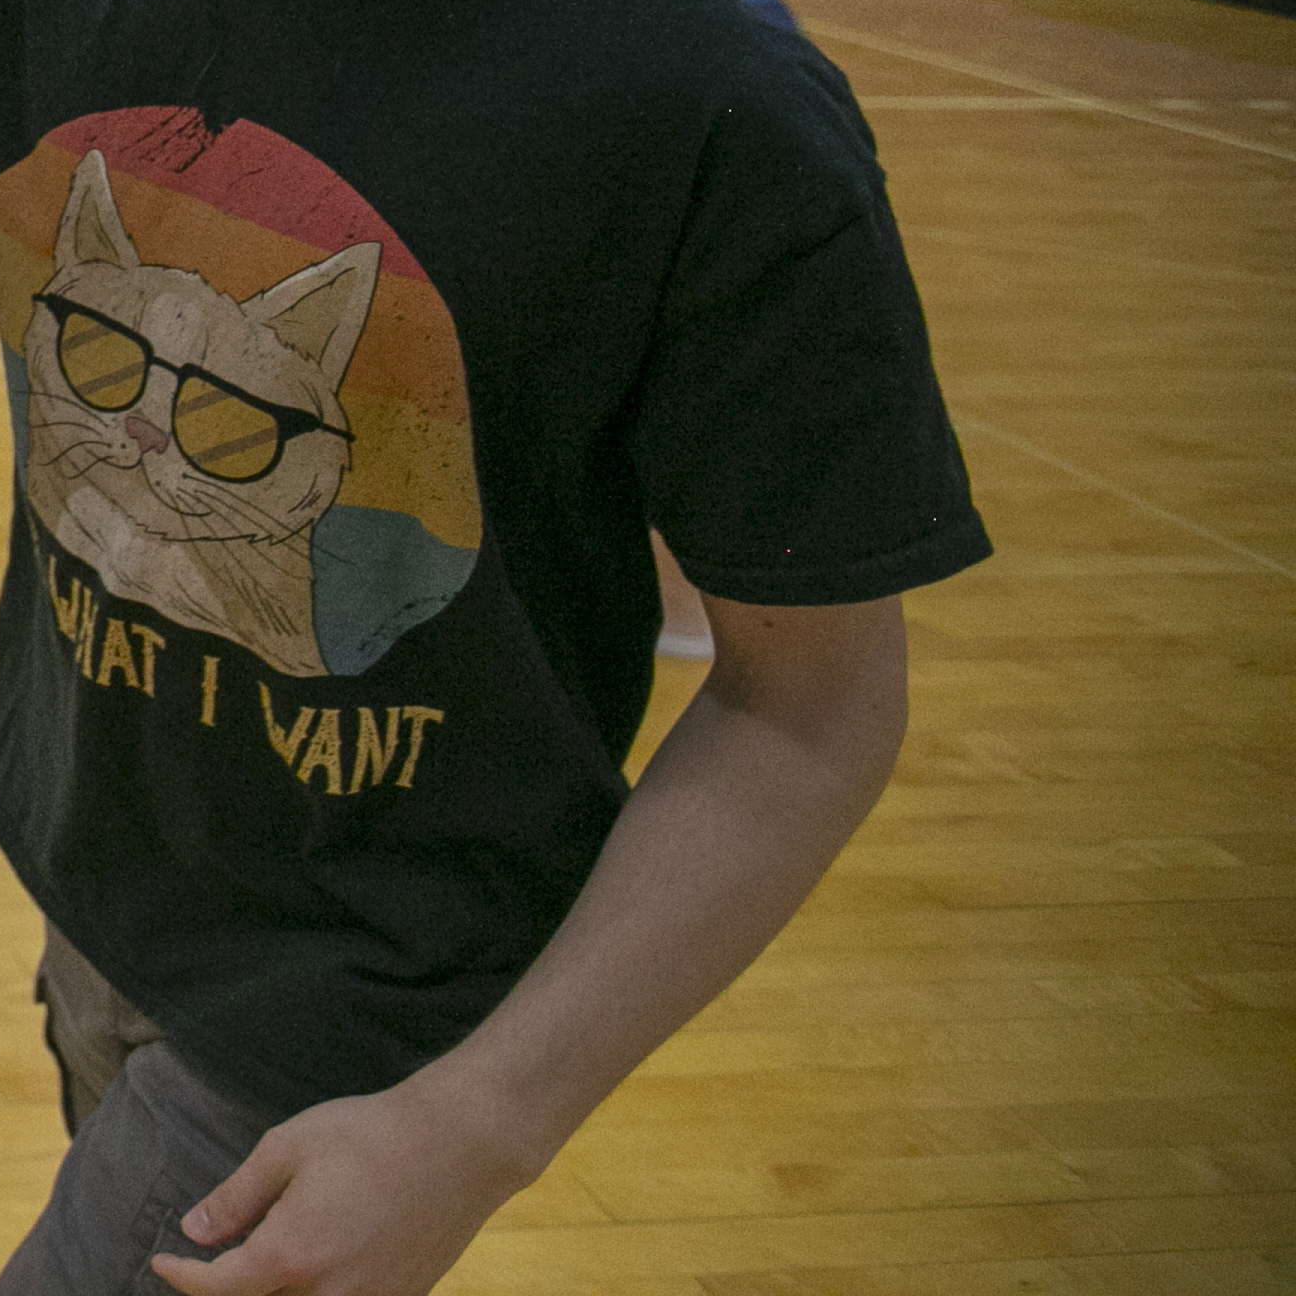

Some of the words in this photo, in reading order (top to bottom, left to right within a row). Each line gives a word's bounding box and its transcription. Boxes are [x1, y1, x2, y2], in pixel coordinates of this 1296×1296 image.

[47, 554, 166, 699] WHAT
[200, 655, 221, 727] I
[258, 680, 445, 795] WANT
